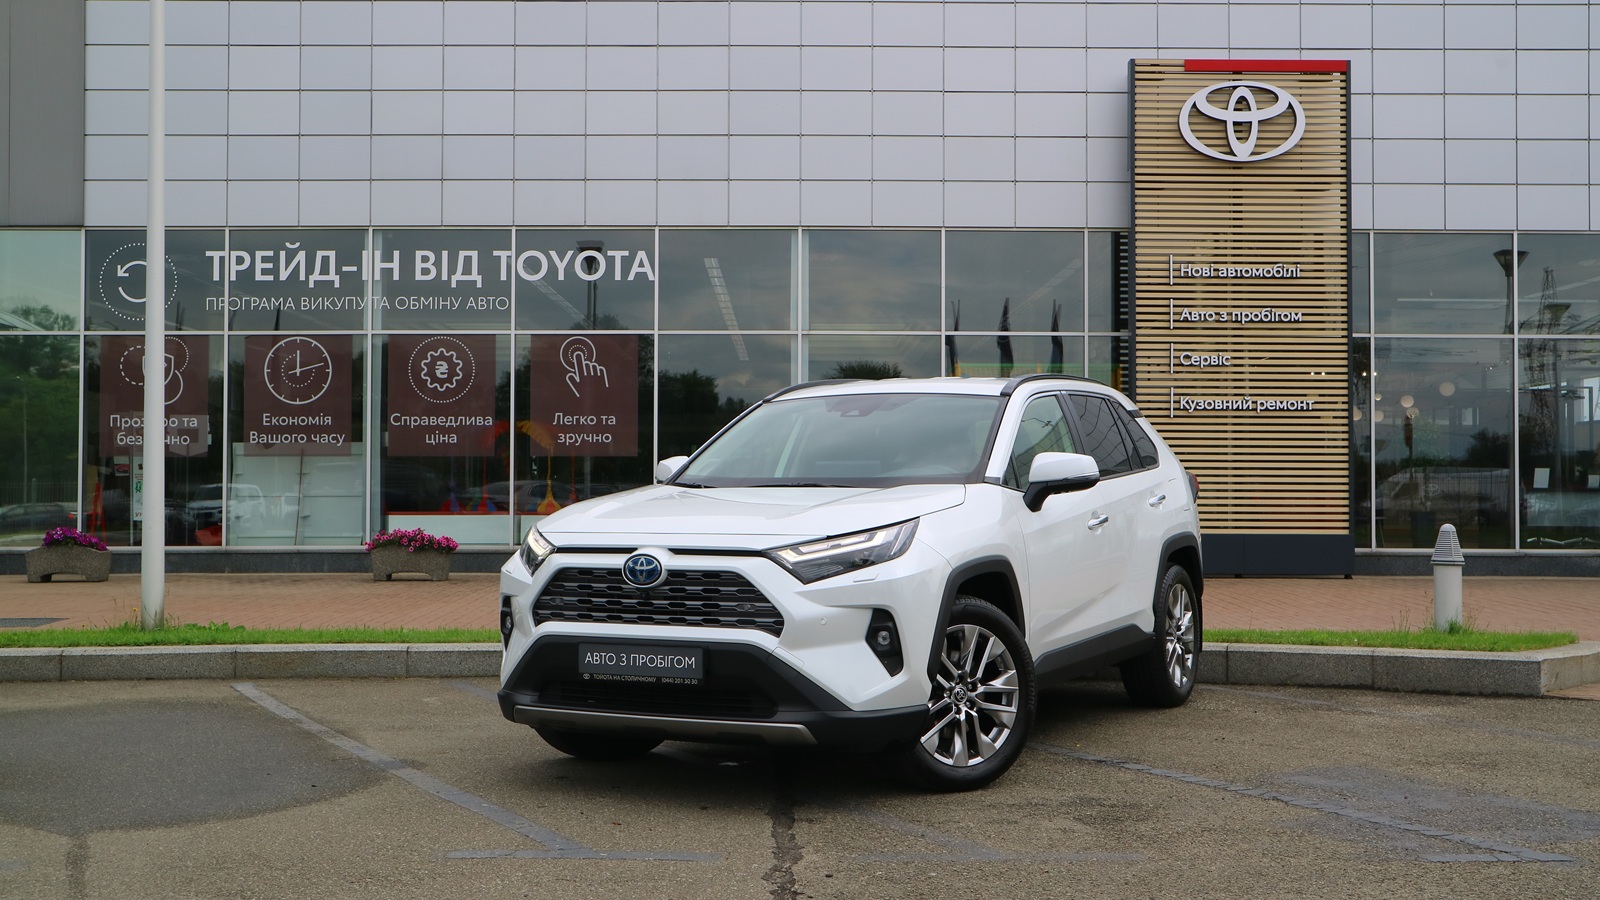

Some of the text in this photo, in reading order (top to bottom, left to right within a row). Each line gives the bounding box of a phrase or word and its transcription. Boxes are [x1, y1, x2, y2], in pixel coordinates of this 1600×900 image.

[205, 242, 655, 288] ТРЕЙД-ІН ВІД TOYOTA
[1180, 263, 1301, 278] Нові автомобілі
[205, 296, 510, 311] ПРОГРАМА ВИКУПУ ТА ОБМІНУ АВТО
[1180, 307, 1303, 325] Авто з пробігом
[1180, 352, 1231, 369] Сервіс
[1180, 395, 1315, 413] Кузовний ремонт
[182, 417, 198, 428] та
[262, 413, 332, 426] Економія
[390, 413, 493, 427] Справедлива
[552, 412, 616, 426] Легко та
[117, 432, 190, 446] безчно
[250, 431, 345, 447] Вашого часу
[425, 431, 458, 444] ціна
[557, 432, 612, 446] зручно
[585, 653, 695, 668] АВТО З ПРОБІГОМ
